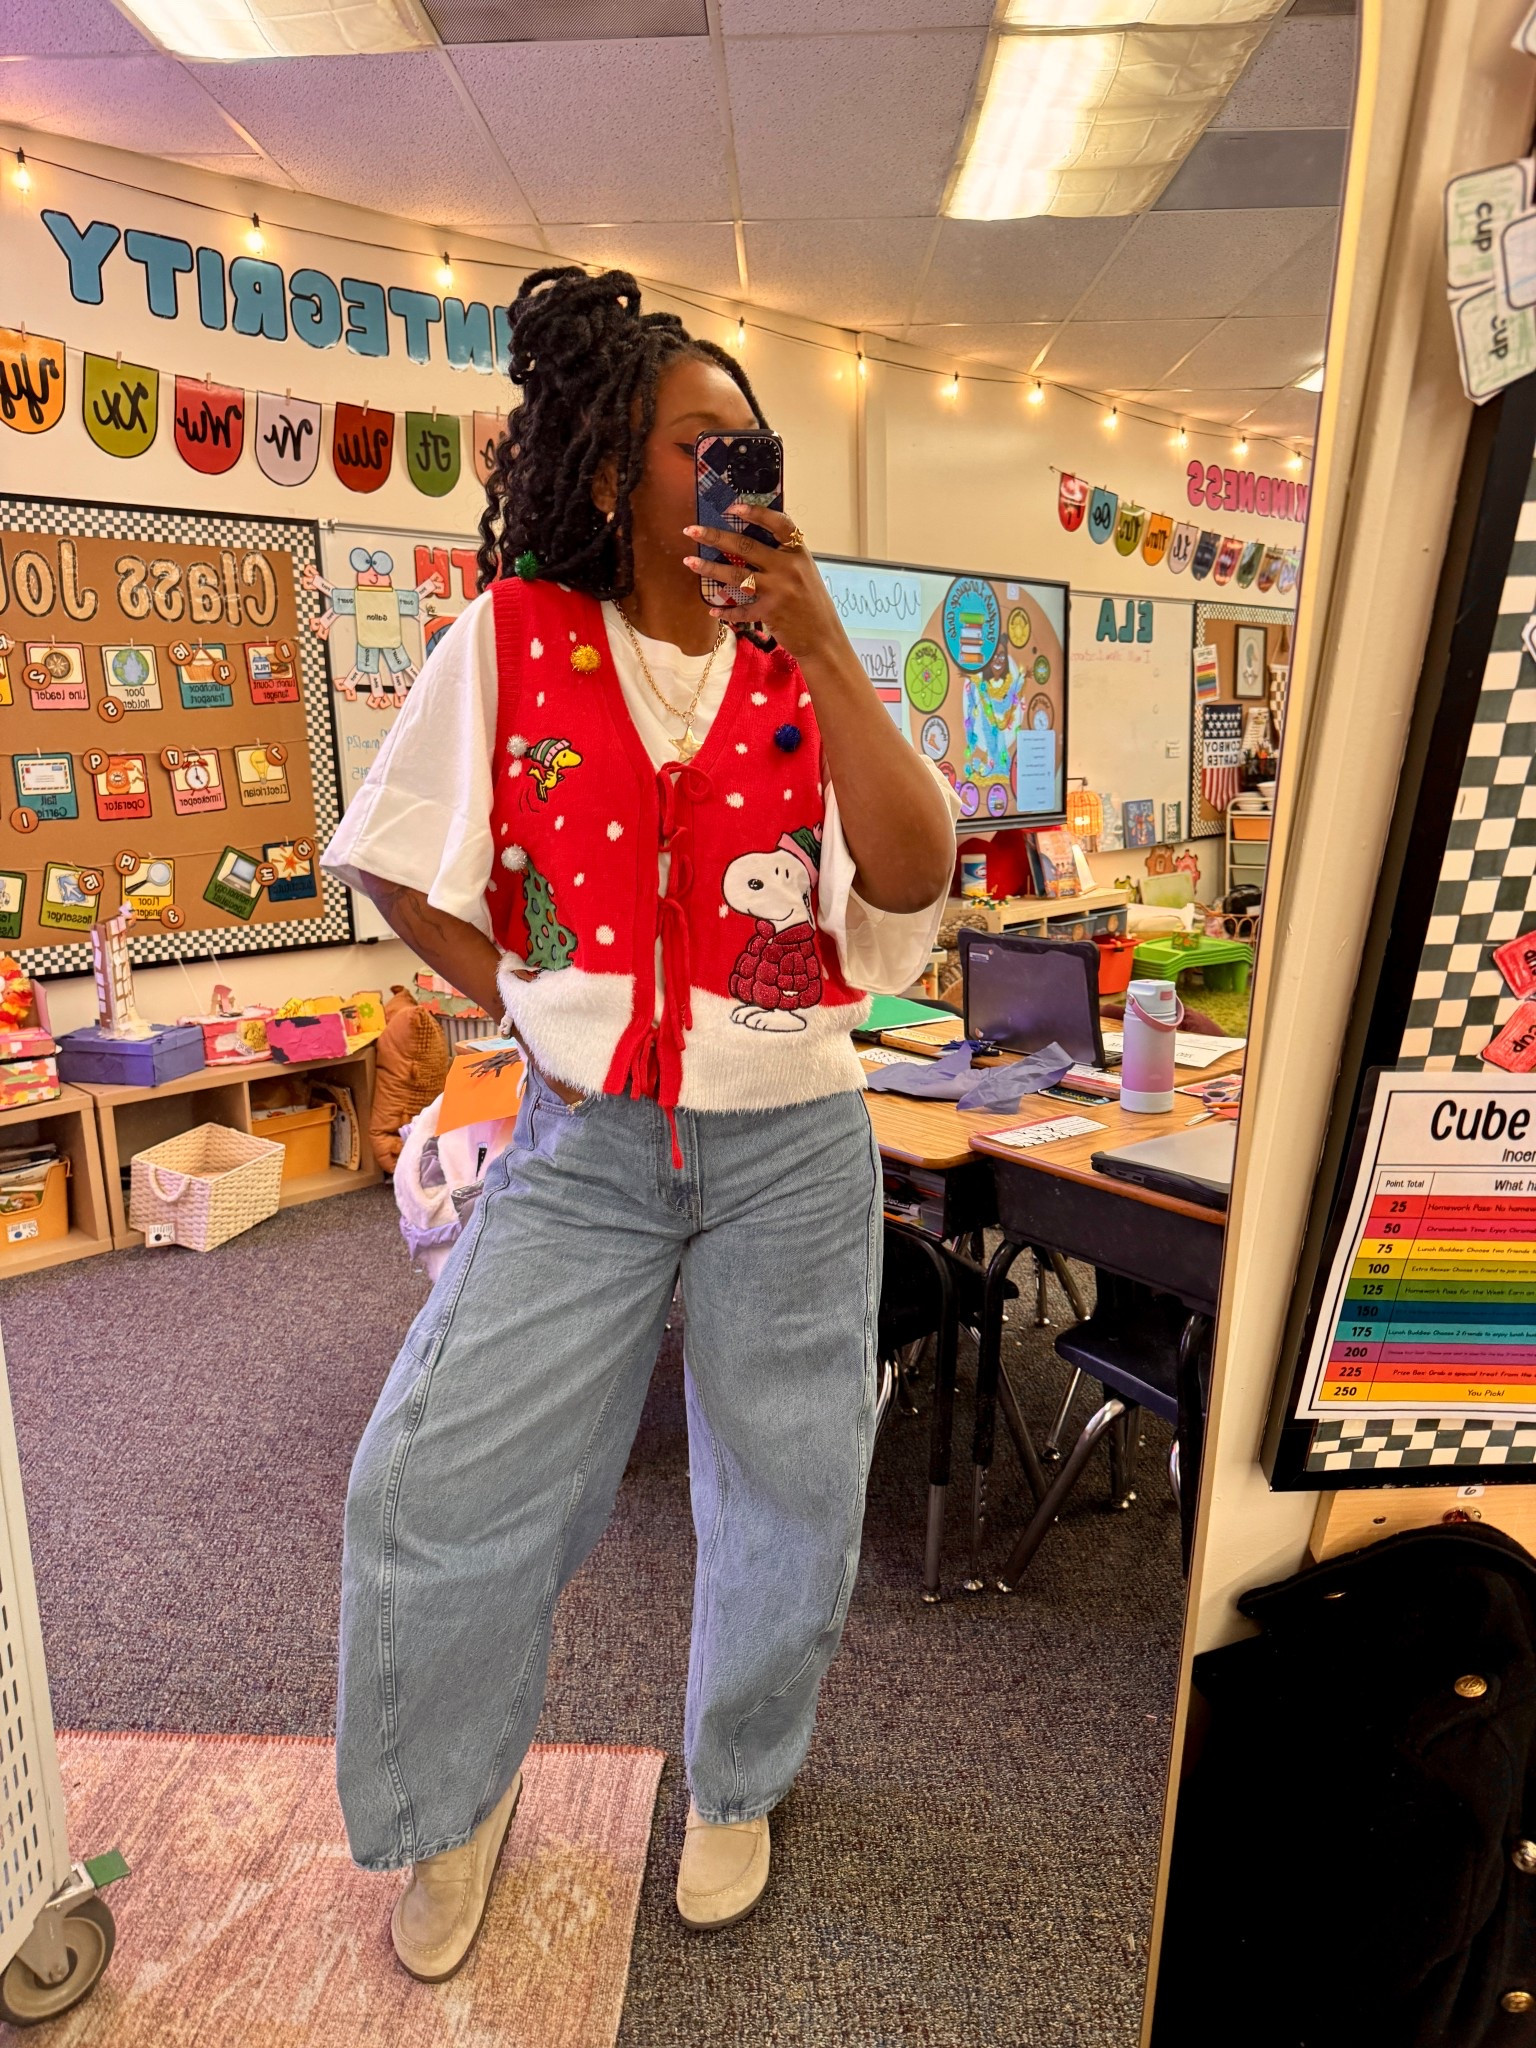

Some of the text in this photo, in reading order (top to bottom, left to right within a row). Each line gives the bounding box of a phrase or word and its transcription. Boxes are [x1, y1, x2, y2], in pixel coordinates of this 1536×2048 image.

[1472, 202, 1492, 253] cup
[1431, 1100, 1530, 1141] Cube
[1386, 1180, 1424, 1188] Point Total
[1495, 1180, 1524, 1191] What
[1390, 1202, 1406, 1212] 25
[1428, 1204, 1470, 1212] Homework
[1384, 1224, 1400, 1234] 50
[1377, 1244, 1393, 1254] 75
[1368, 1264, 1390, 1274] 100
[1362, 1284, 1384, 1296] 125
[1356, 1306, 1378, 1316] 150
[1352, 1326, 1372, 1337] 175
[1344, 1346, 1368, 1357] 200
[1339, 1367, 1362, 1377] 225
[1334, 1386, 1358, 1397] 250
